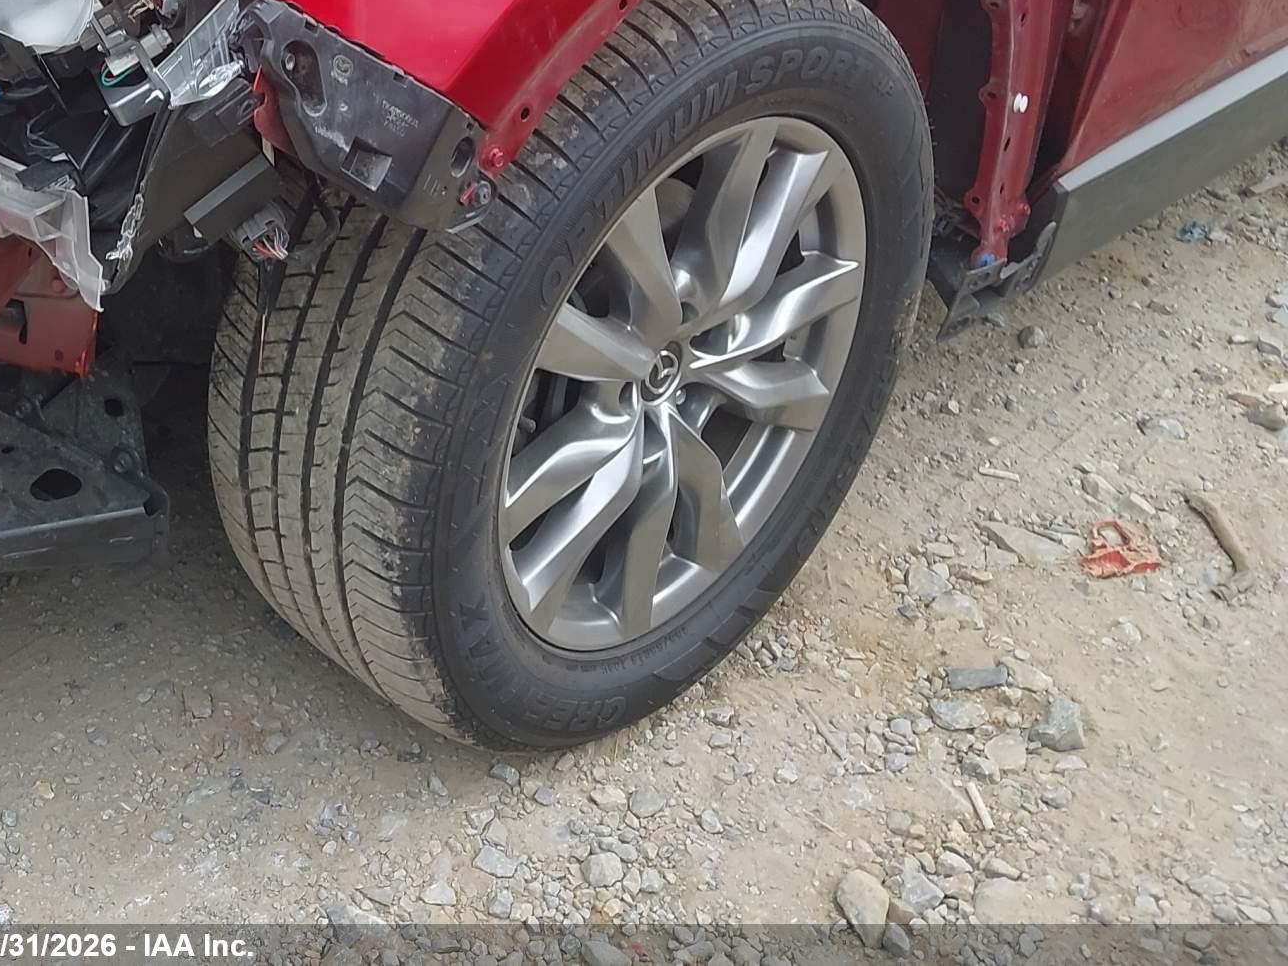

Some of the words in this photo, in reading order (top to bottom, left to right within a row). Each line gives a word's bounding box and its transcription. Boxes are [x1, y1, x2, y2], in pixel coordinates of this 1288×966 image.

[540, 69, 738, 310] OPTIMUM
[745, 44, 872, 94] SPORT
[458, 593, 627, 732] GREEMAX
